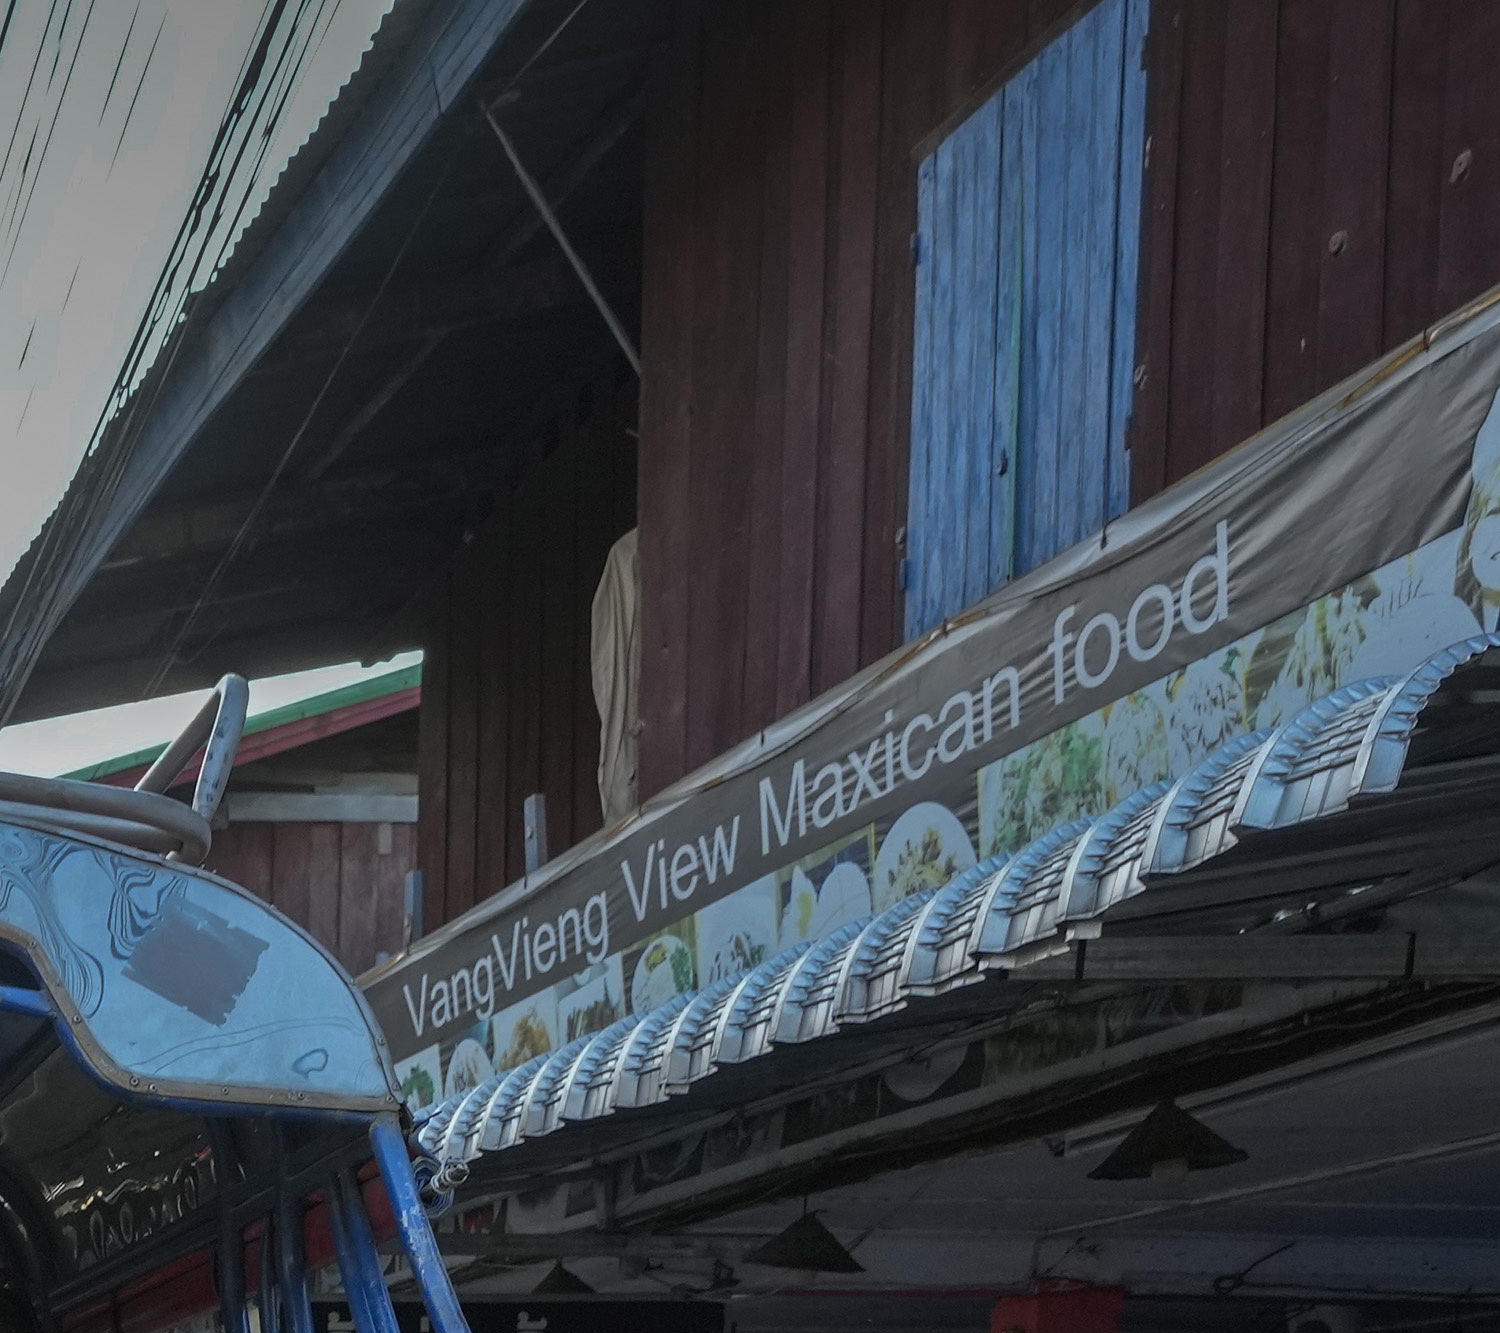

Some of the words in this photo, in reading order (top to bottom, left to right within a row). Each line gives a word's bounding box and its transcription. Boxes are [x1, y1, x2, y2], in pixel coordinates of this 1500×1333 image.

[403, 890, 609, 1037] VangVieng
[621, 814, 740, 923] View
[758, 709, 1021, 856] Maxican
[1046, 519, 1229, 705] food
